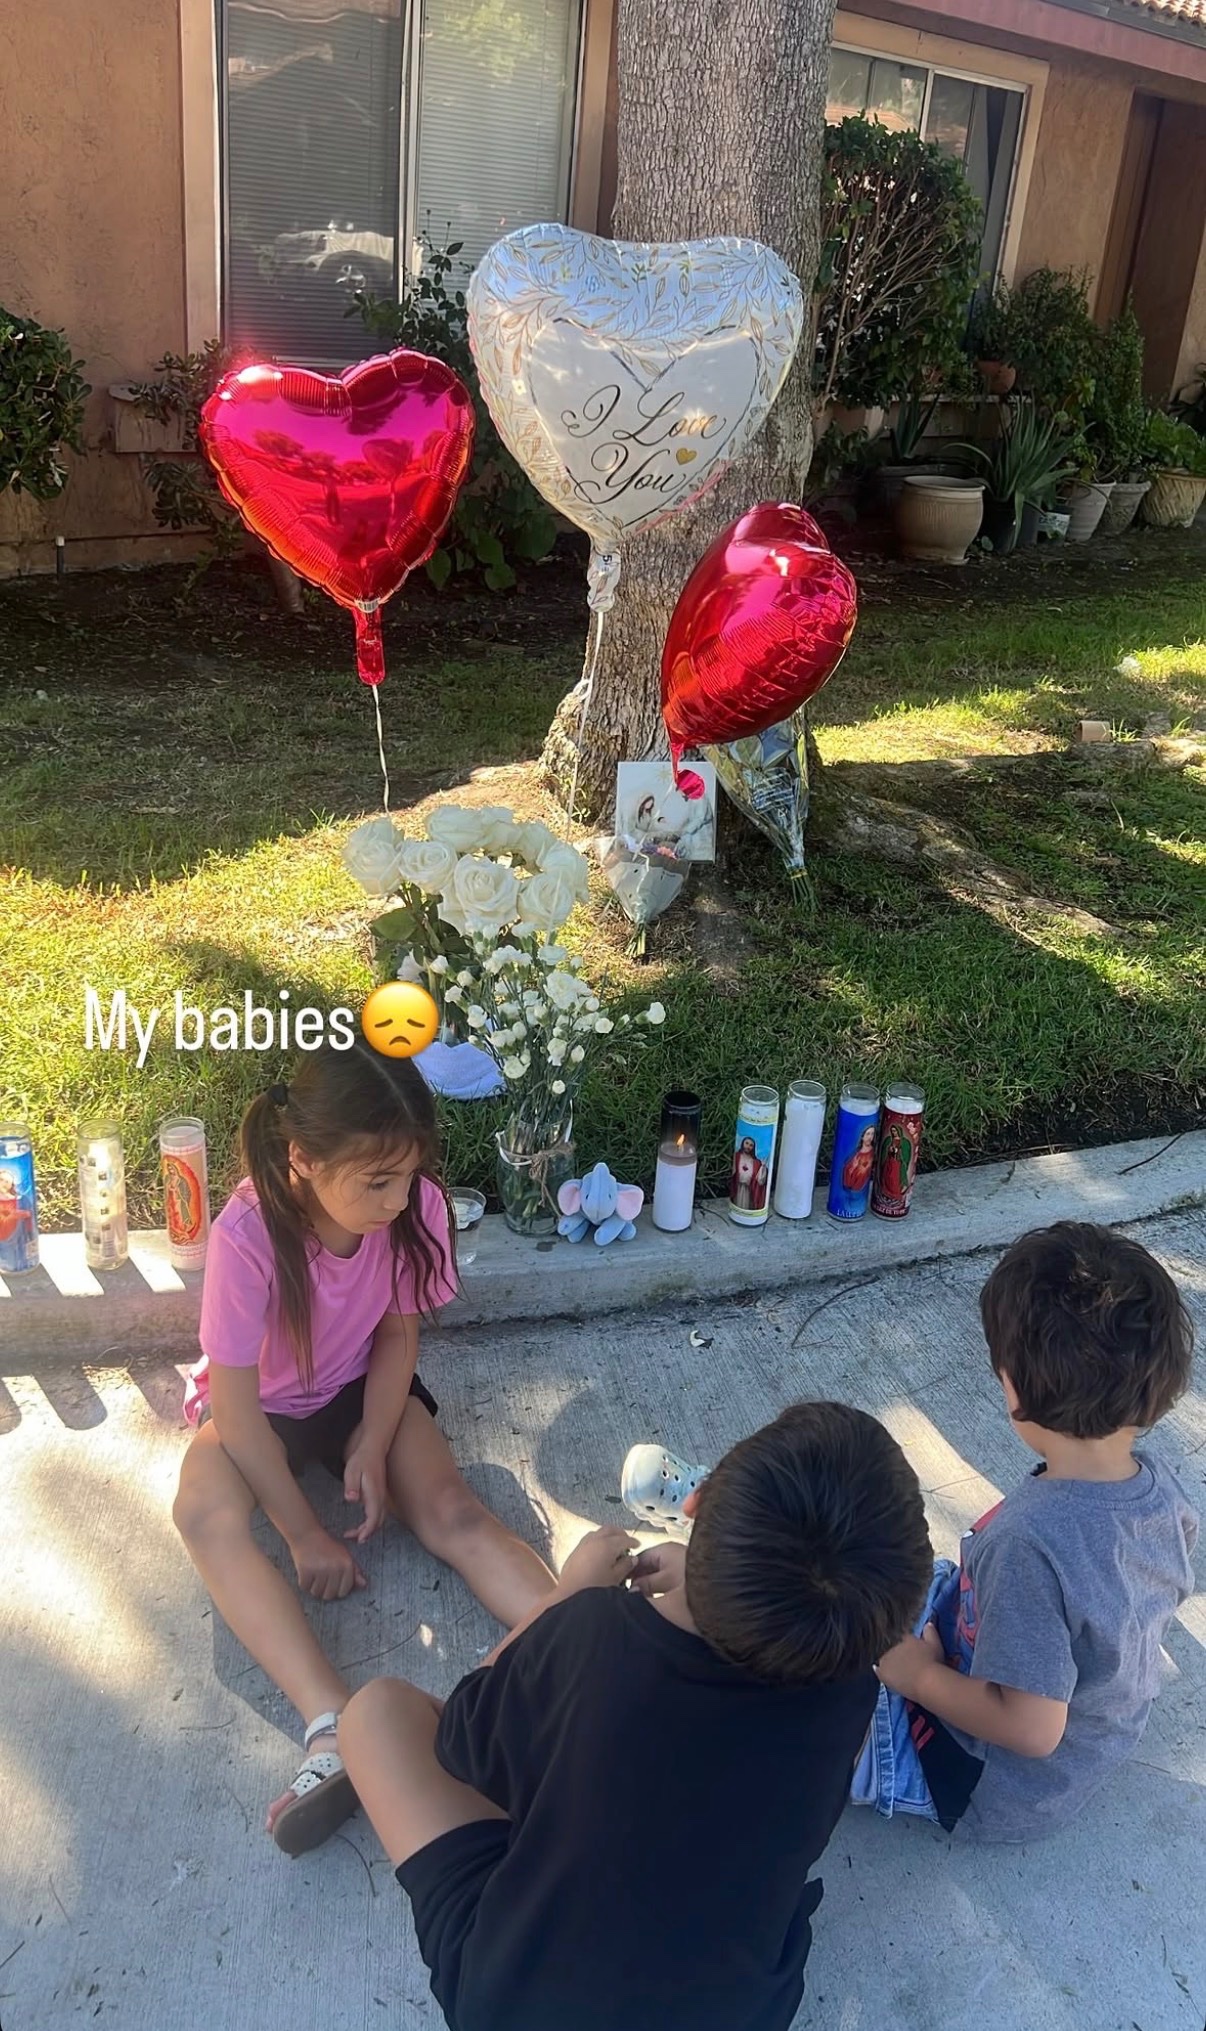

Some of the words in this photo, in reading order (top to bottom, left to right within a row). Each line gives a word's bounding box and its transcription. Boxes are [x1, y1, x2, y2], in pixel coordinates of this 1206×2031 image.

[561, 385, 620, 438] I
[612, 391, 727, 446] Love
[574, 442, 686, 505] You
